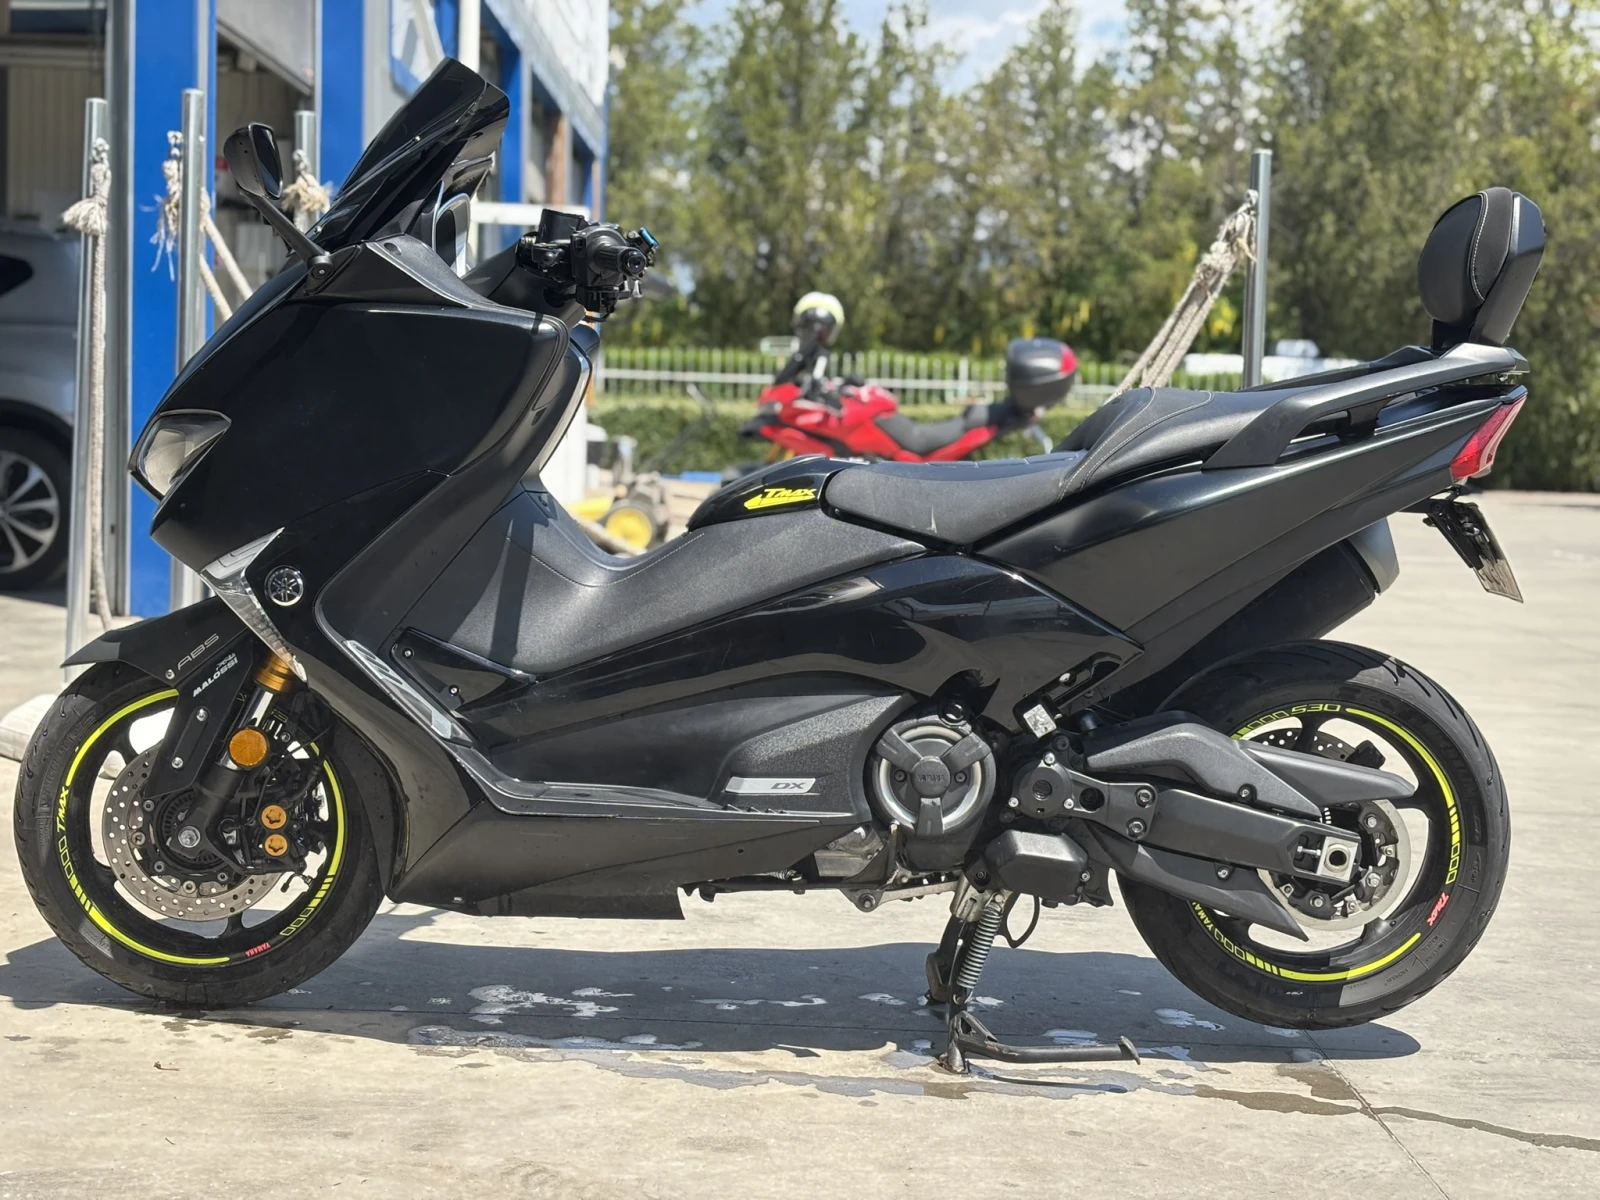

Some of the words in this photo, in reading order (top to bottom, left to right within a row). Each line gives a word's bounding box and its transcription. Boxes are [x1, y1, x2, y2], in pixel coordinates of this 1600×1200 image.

[178, 633, 219, 670] ABS
[193, 657, 239, 697] MALOSSI
[770, 782, 807, 790] DX
[56, 786, 70, 833] TMAX
[1427, 892, 1450, 927] TMAX
[245, 942, 271, 957] YAMAHA
